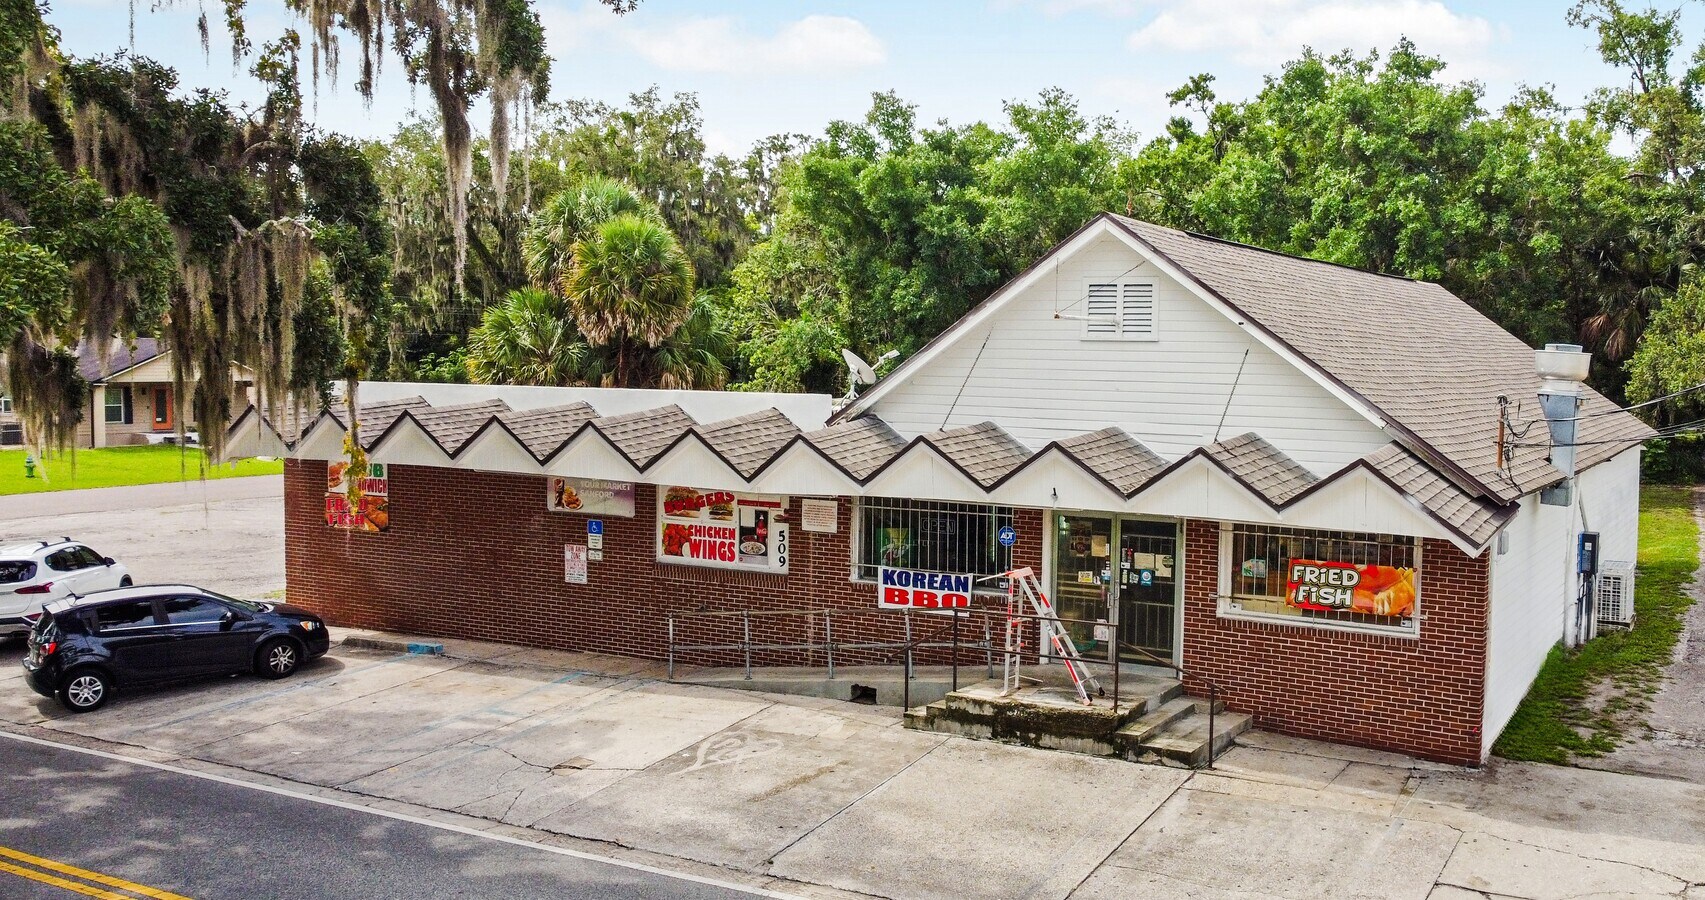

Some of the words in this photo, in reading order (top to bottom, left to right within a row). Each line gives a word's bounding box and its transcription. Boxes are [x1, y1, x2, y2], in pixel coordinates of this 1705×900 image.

[663, 491, 735, 514] BURGERS
[327, 512, 366, 527] FISH
[687, 524, 736, 541] CHICKEN
[1000, 532, 1015, 540] ADT
[688, 538, 736, 562] WINGS
[882, 568, 969, 593] KOREAN
